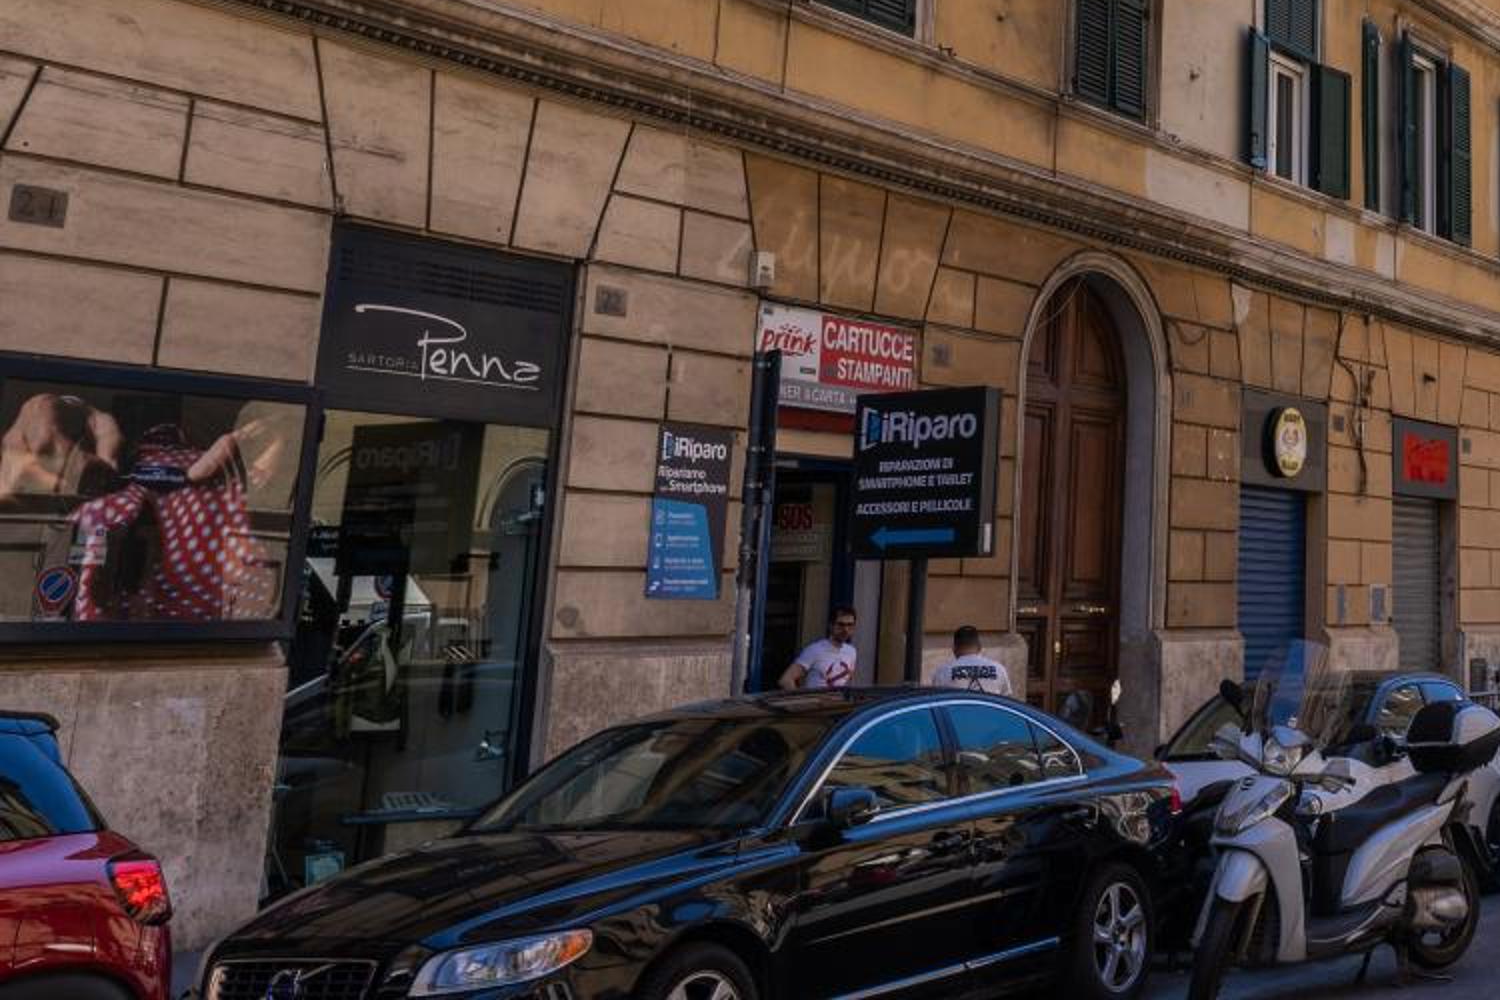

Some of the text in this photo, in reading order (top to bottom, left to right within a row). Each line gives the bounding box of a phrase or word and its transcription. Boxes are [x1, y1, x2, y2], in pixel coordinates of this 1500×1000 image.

[355, 303, 541, 381] Penna
[759, 327, 816, 355] prink
[823, 321, 913, 362] CARTUCCE
[348, 353, 419, 371] SARTORIA
[837, 357, 913, 390] STAMPANTI
[882, 411, 977, 449] iRiparo
[674, 436, 727, 463] iRiparo
[858, 476, 927, 490] SMARTPHONE
[857, 502, 910, 515] ACCESSORI
[919, 498, 972, 512] PELLICOLE
